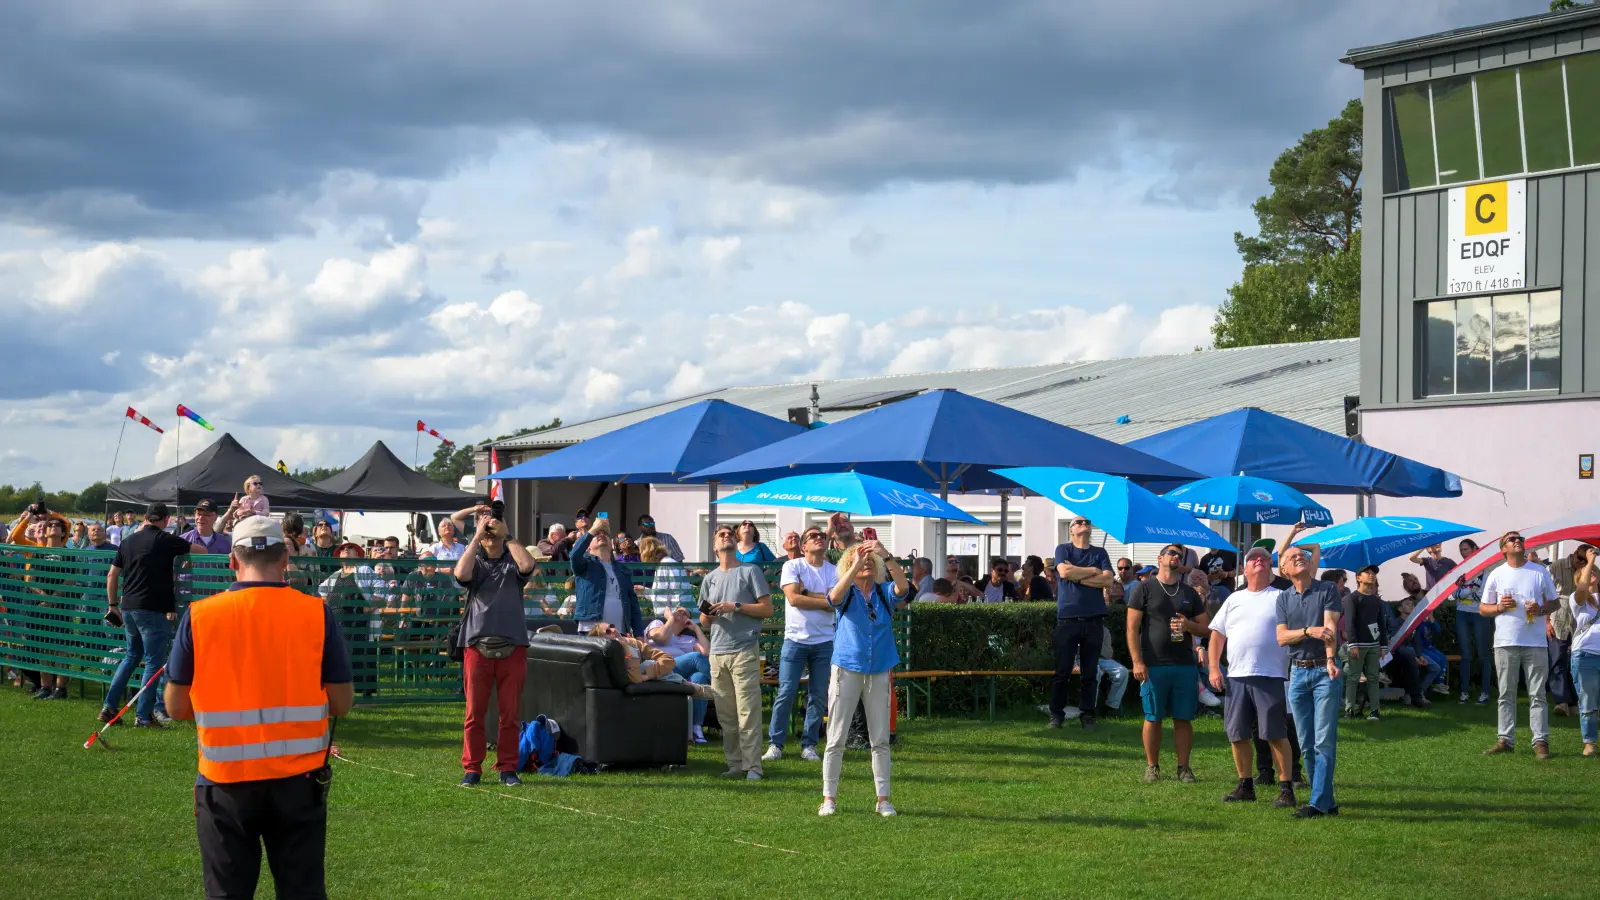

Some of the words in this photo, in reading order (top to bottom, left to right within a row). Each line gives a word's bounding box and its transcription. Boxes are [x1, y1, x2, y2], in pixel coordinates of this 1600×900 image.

[1475, 193, 1496, 224] C
[1461, 238, 1511, 260] EDQF
[1474, 265, 1496, 275] ELEV.
[1450, 281, 1473, 293] 1370
[1475, 280, 1482, 291] ft
[1490, 277, 1509, 288] 418
[1512, 278, 1522, 287] m
[770, 493, 803, 501] AQUA
[805, 495, 849, 504] VERITAS
[1177, 502, 1230, 516] SHUI
[1156, 527, 1180, 536] AQUA
[1179, 529, 1210, 541] VERITAS
